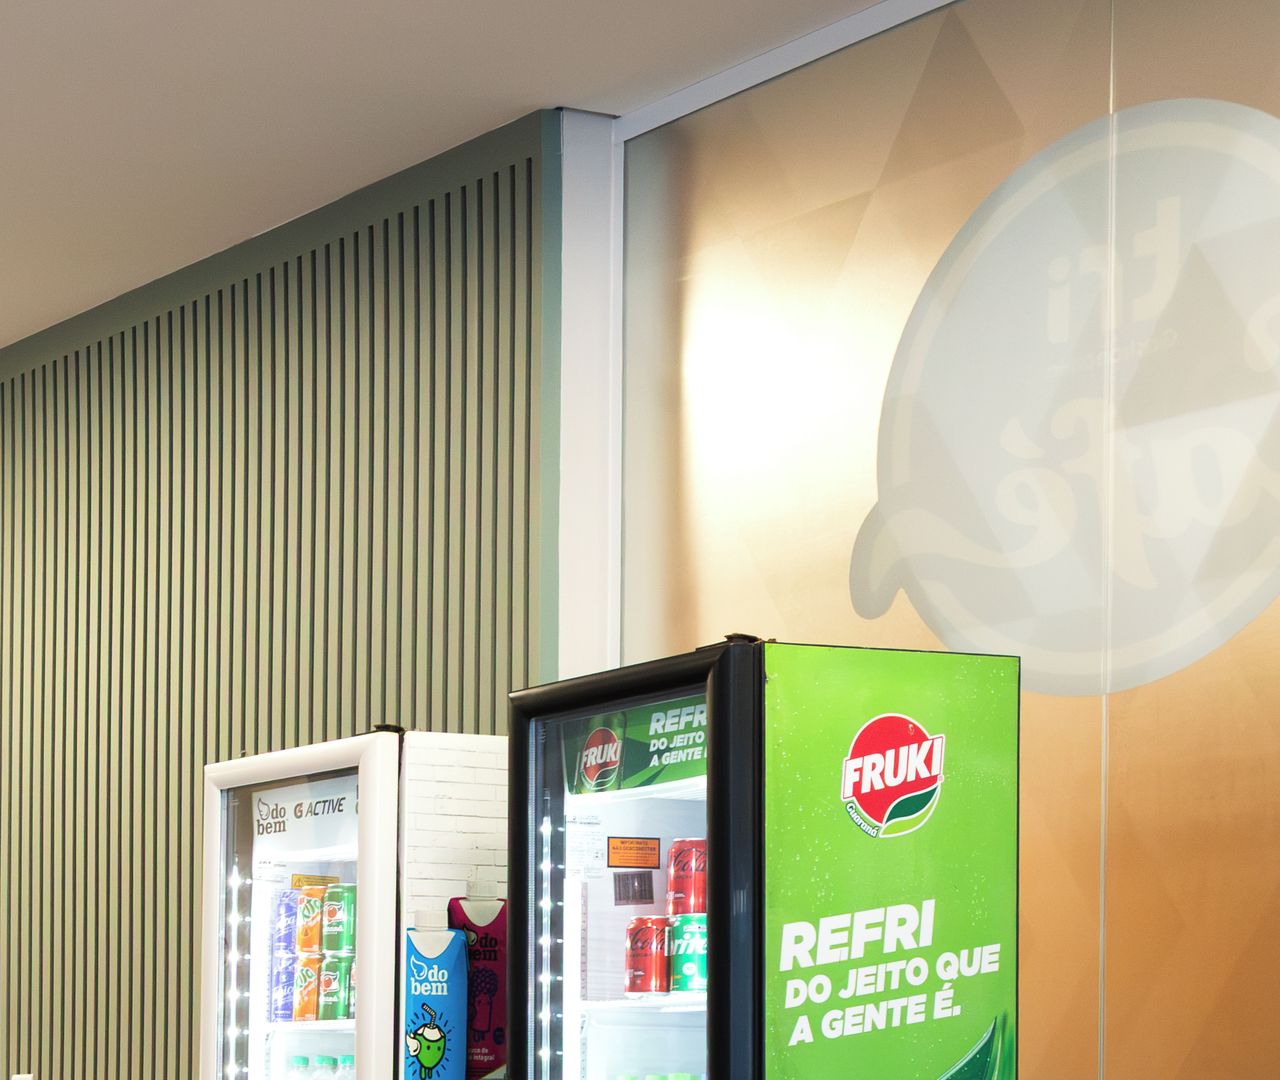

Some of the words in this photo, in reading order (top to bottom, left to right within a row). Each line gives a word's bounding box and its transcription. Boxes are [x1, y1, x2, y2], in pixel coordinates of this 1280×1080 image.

[649, 704, 707, 736] REFR
[649, 738, 667, 752] DO
[670, 731, 705, 748] JEITO
[581, 741, 623, 770] FRUKI
[649, 755, 659, 768] A
[661, 747, 703, 765] GENTE
[842, 737, 944, 799] FRUKI
[271, 803, 286, 819] do
[305, 797, 346, 818] ACTIVE
[256, 819, 287, 836] bem
[846, 802, 879, 838] Guaraná
[673, 932, 707, 955] rite
[779, 898, 936, 972] REFRI
[427, 965, 448, 982] do
[785, 974, 833, 1009] DO
[838, 957, 929, 999] JEITO
[936, 943, 1001, 981] QUE
[410, 978, 448, 996] bem
[788, 1015, 814, 1047] A
[821, 994, 928, 1039] GENTE
[933, 983, 962, 1020] É.
